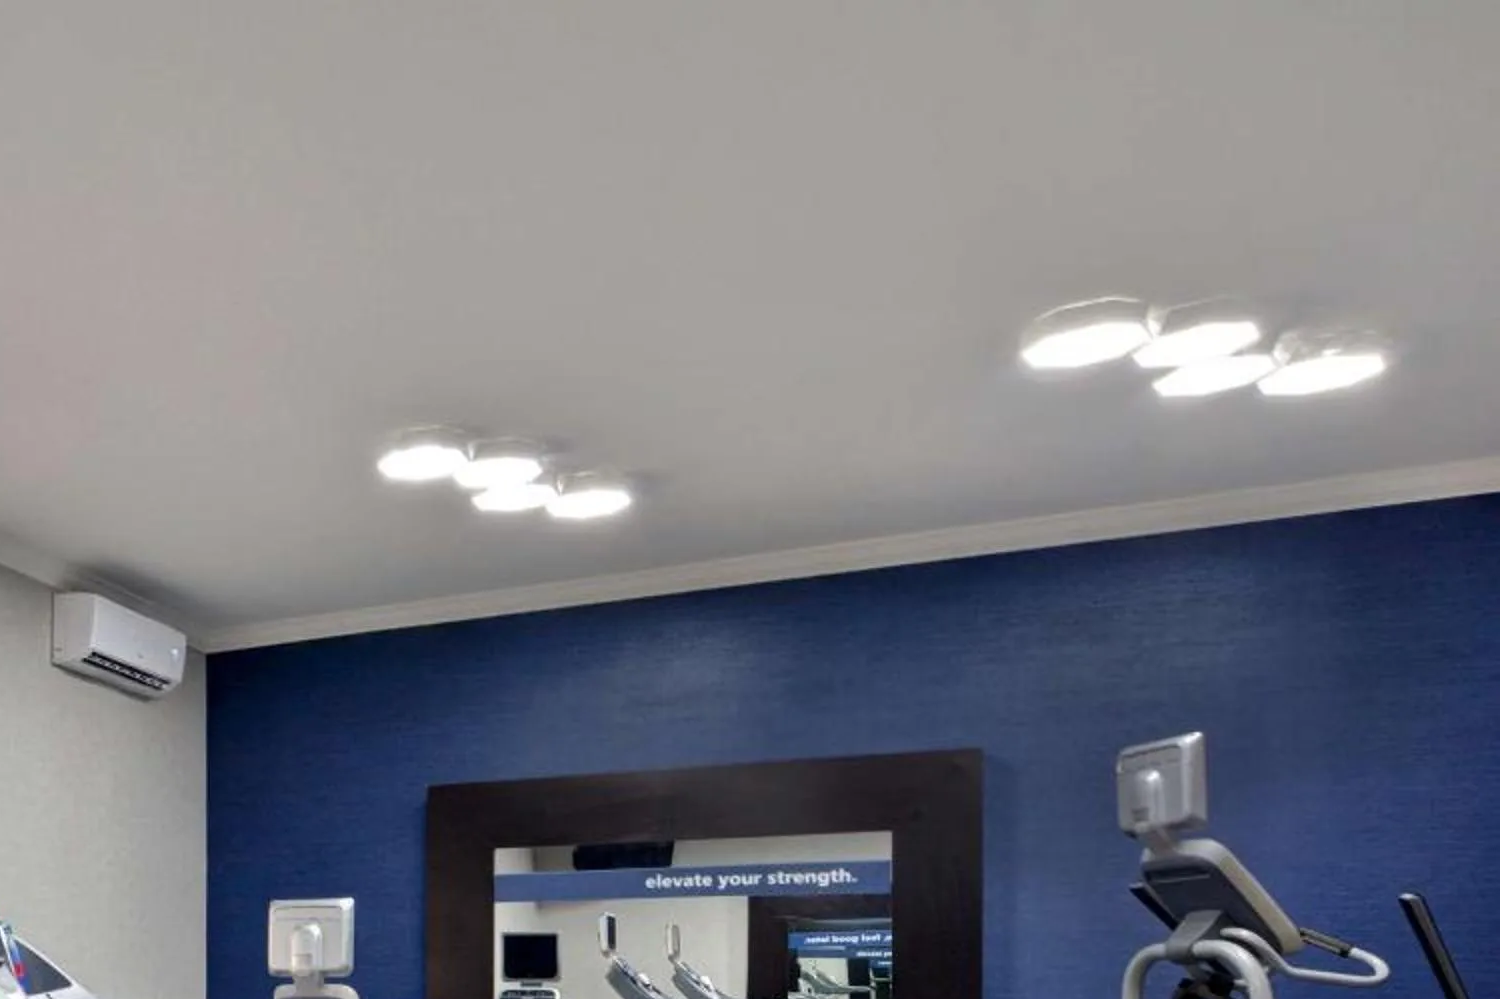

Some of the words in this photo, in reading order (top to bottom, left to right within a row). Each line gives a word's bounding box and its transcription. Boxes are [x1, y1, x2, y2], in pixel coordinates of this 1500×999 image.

[645, 873, 713, 889] elevate
[718, 873, 762, 890] your
[767, 868, 858, 887] strength.
